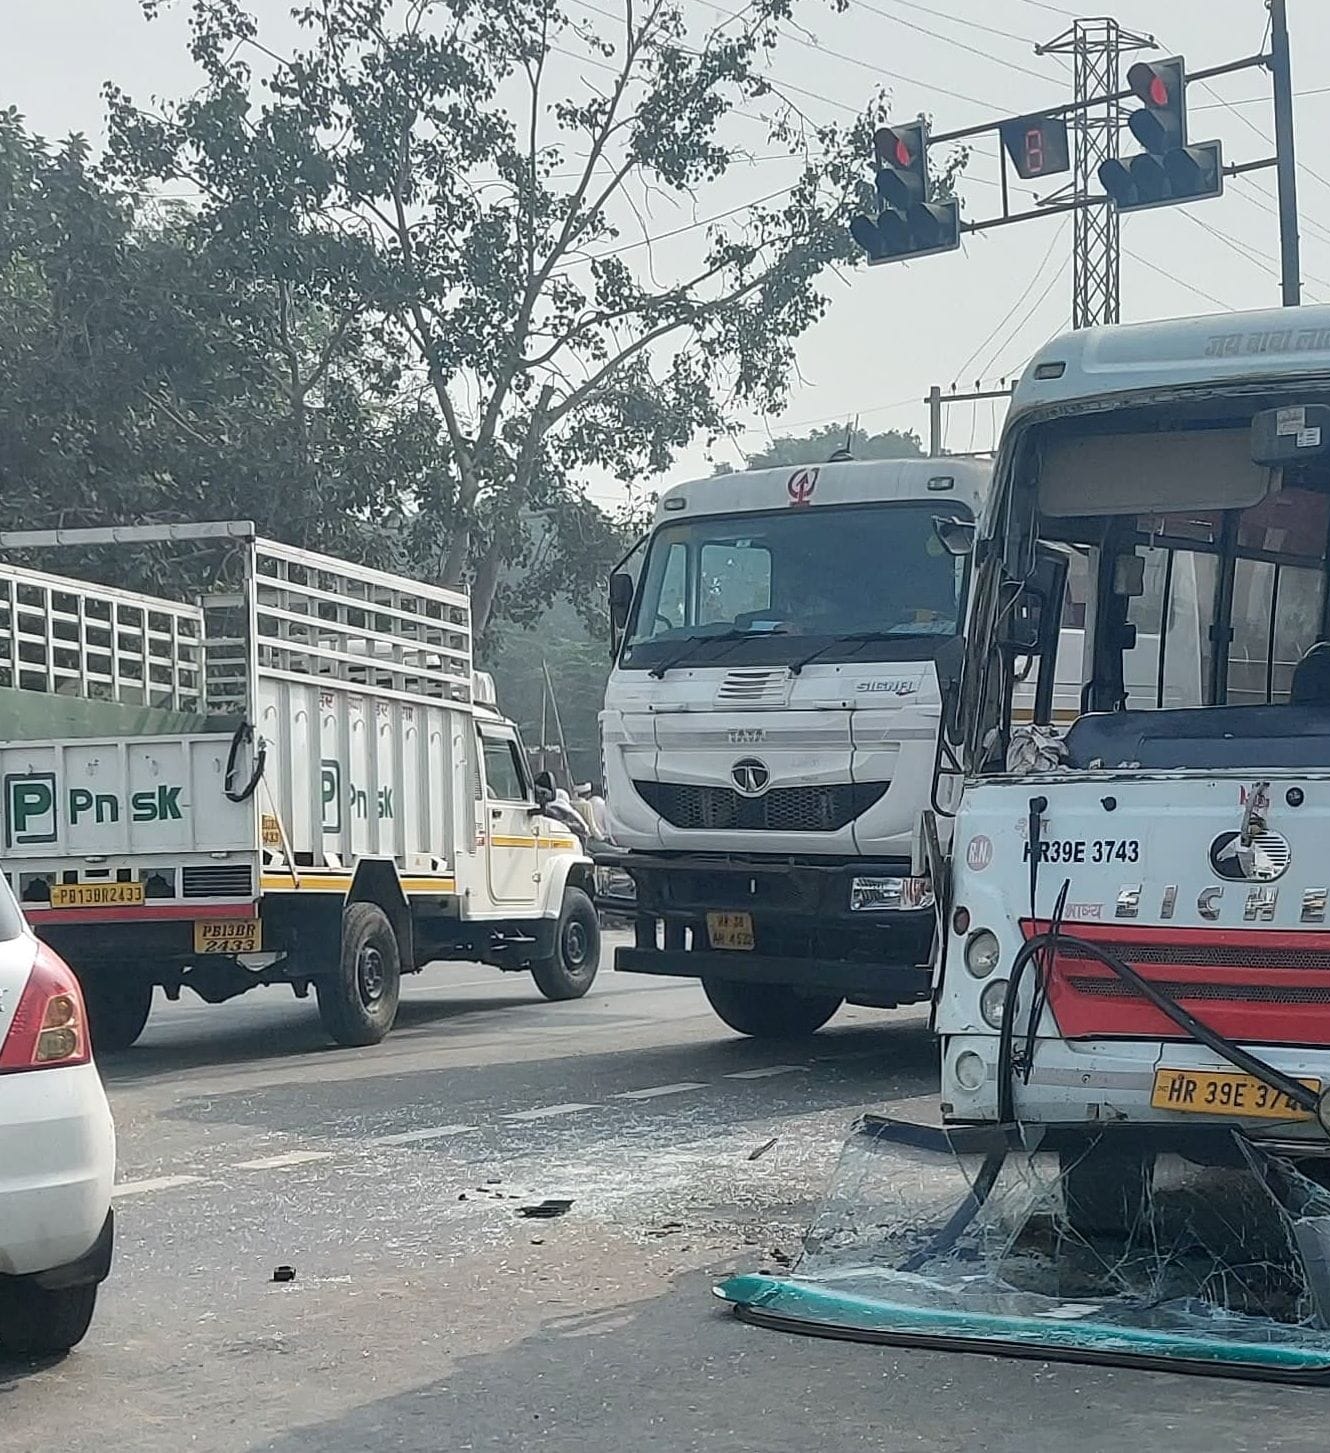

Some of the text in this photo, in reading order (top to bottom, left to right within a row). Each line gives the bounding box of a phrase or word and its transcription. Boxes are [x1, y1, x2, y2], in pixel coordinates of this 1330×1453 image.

[13, 783, 52, 832] P
[1091, 841, 1139, 863] 3743
[204, 939, 256, 952] 2433
[1168, 1078, 1197, 1104] HR
[1204, 1080, 1248, 1107] 39E
